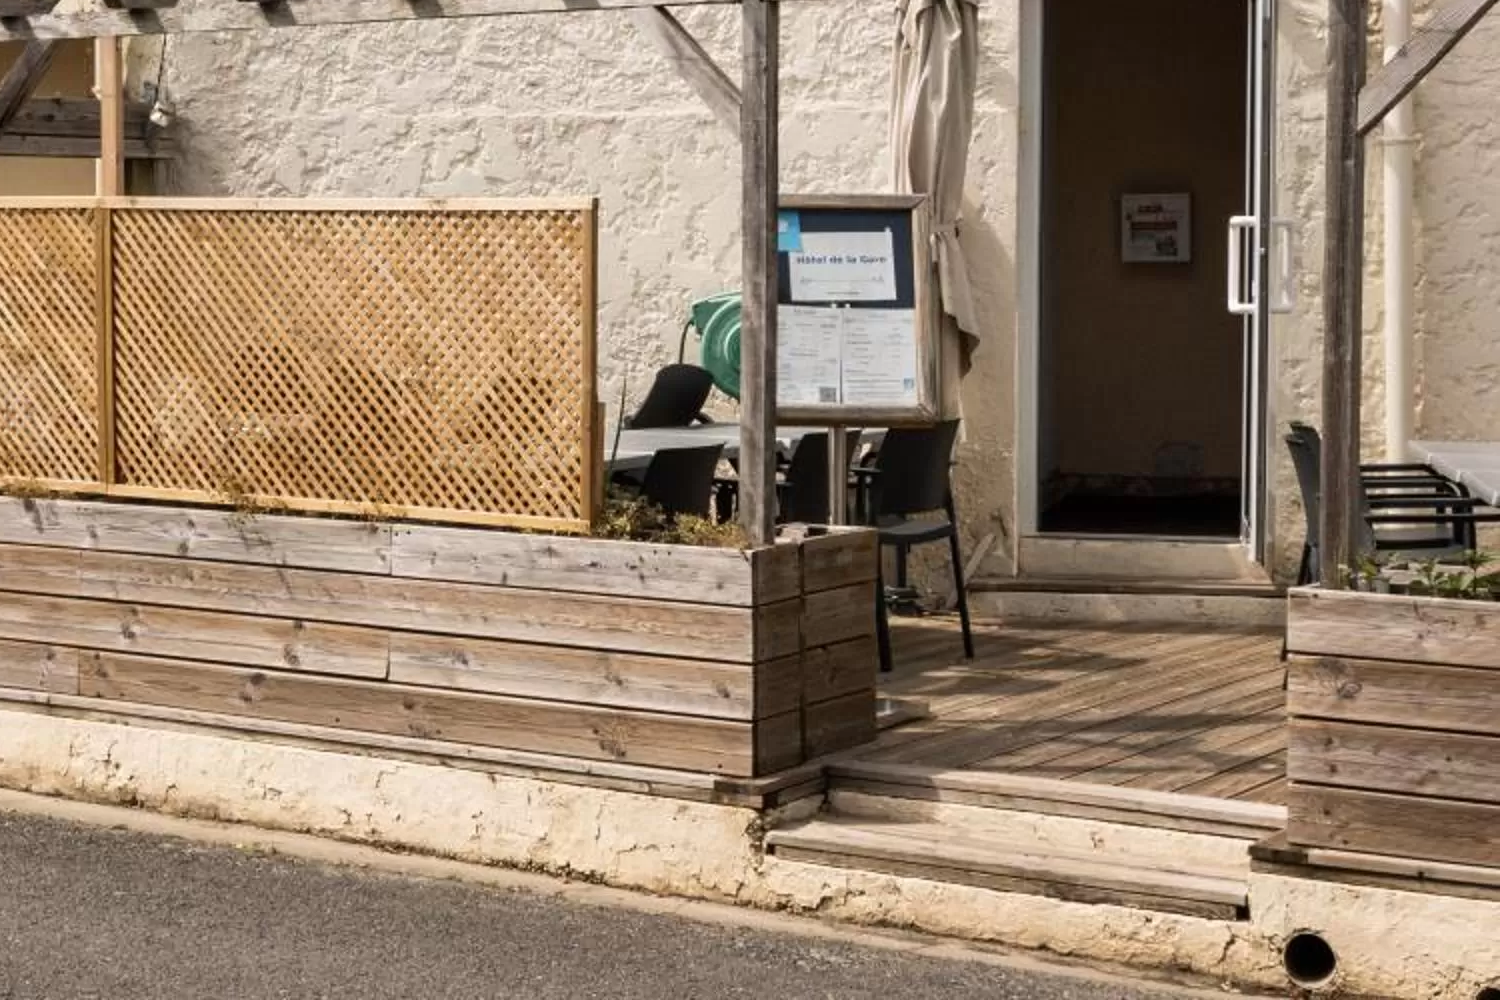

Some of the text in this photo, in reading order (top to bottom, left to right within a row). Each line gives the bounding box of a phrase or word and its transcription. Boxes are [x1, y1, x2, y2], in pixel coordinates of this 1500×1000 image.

[797, 254, 827, 265] Hôtel
[829, 255, 842, 265] de
[846, 255, 857, 265] la
